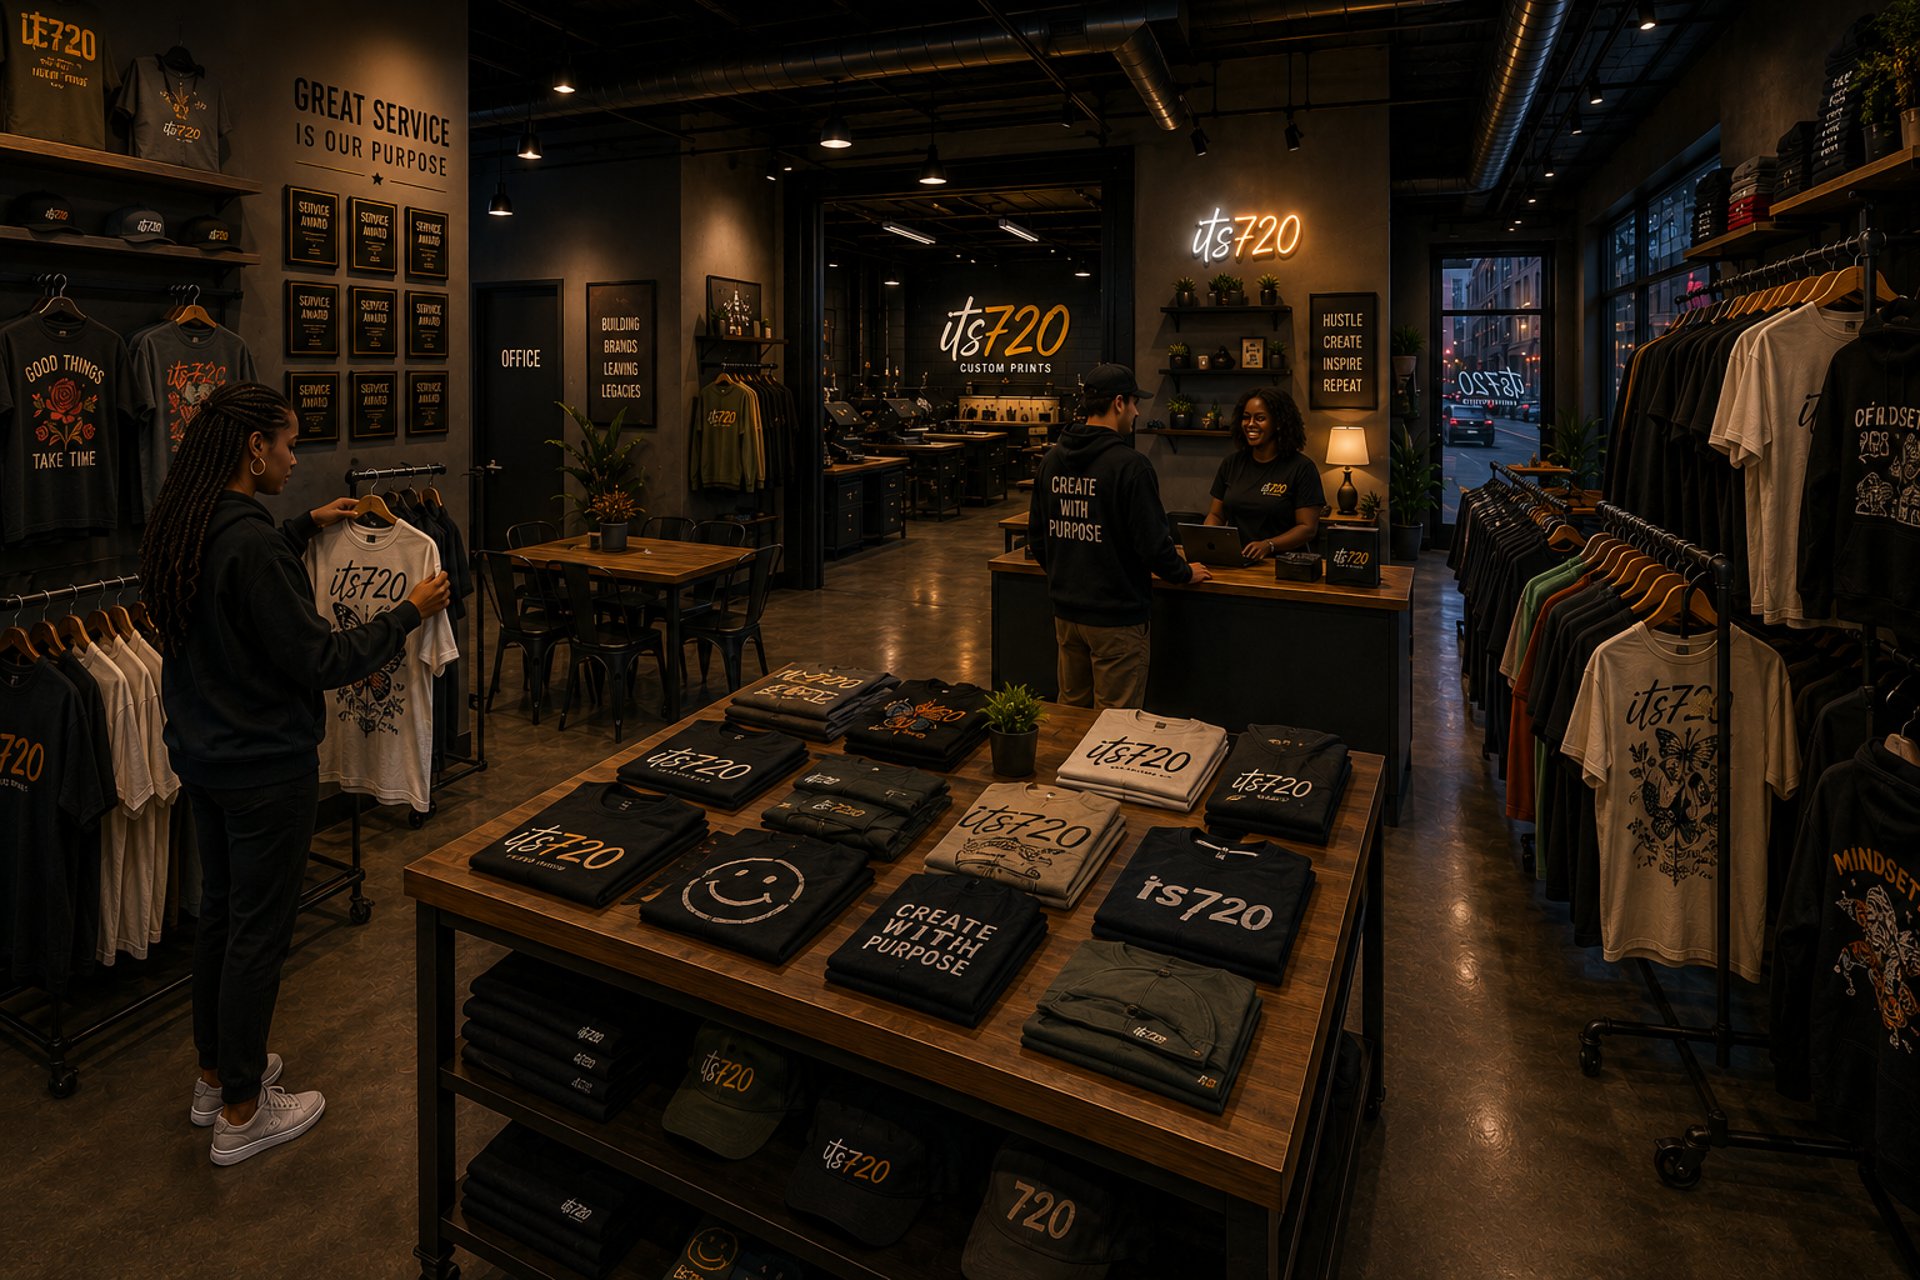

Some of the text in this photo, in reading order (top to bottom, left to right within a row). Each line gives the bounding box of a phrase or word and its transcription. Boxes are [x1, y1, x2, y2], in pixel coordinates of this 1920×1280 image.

[294, 77, 450, 148] GREAT SERVICE
[296, 122, 447, 177] IS OUR PURPOSE
[1192, 207, 1301, 263] its720
[601, 317, 640, 331] BUILDING
[940, 296, 1071, 361] its720
[1322, 313, 1364, 328] HUSTLE
[501, 349, 541, 368] OFFICE
[604, 340, 638, 354] BRANDS
[1322, 335, 1363, 349] CREATE
[24, 354, 105, 385] GOOD THINGS
[604, 362, 638, 376] LEAVING
[960, 363, 1051, 373] CUSTOM PRINTS
[1322, 357, 1363, 371] INSPIRE
[601, 384, 641, 399] LEGACIES
[1322, 378, 1363, 393] REPEAT
[32, 450, 96, 470] TAKE TIME
[1051, 475, 1097, 497] CREATE
[1060, 498, 1089, 519] WITH
[1049, 519, 1103, 543] PURPOSE
[329, 559, 407, 602] its720
[1626, 679, 1734, 731] its72
[646, 747, 752, 780] its720
[1086, 736, 1191, 773] its720
[1231, 768, 1313, 798] its720
[958, 805, 1092, 849] its720
[504, 824, 626, 870] its720
[1832, 846, 1920, 902] MINDSET
[881, 917, 984, 960] WITH
[895, 903, 998, 942] CREATE
[862, 934, 971, 977] PURPOSE
[700, 1050, 755, 1093] its720
[823, 1138, 891, 1185] its720
[1006, 1180, 1077, 1240] 720
